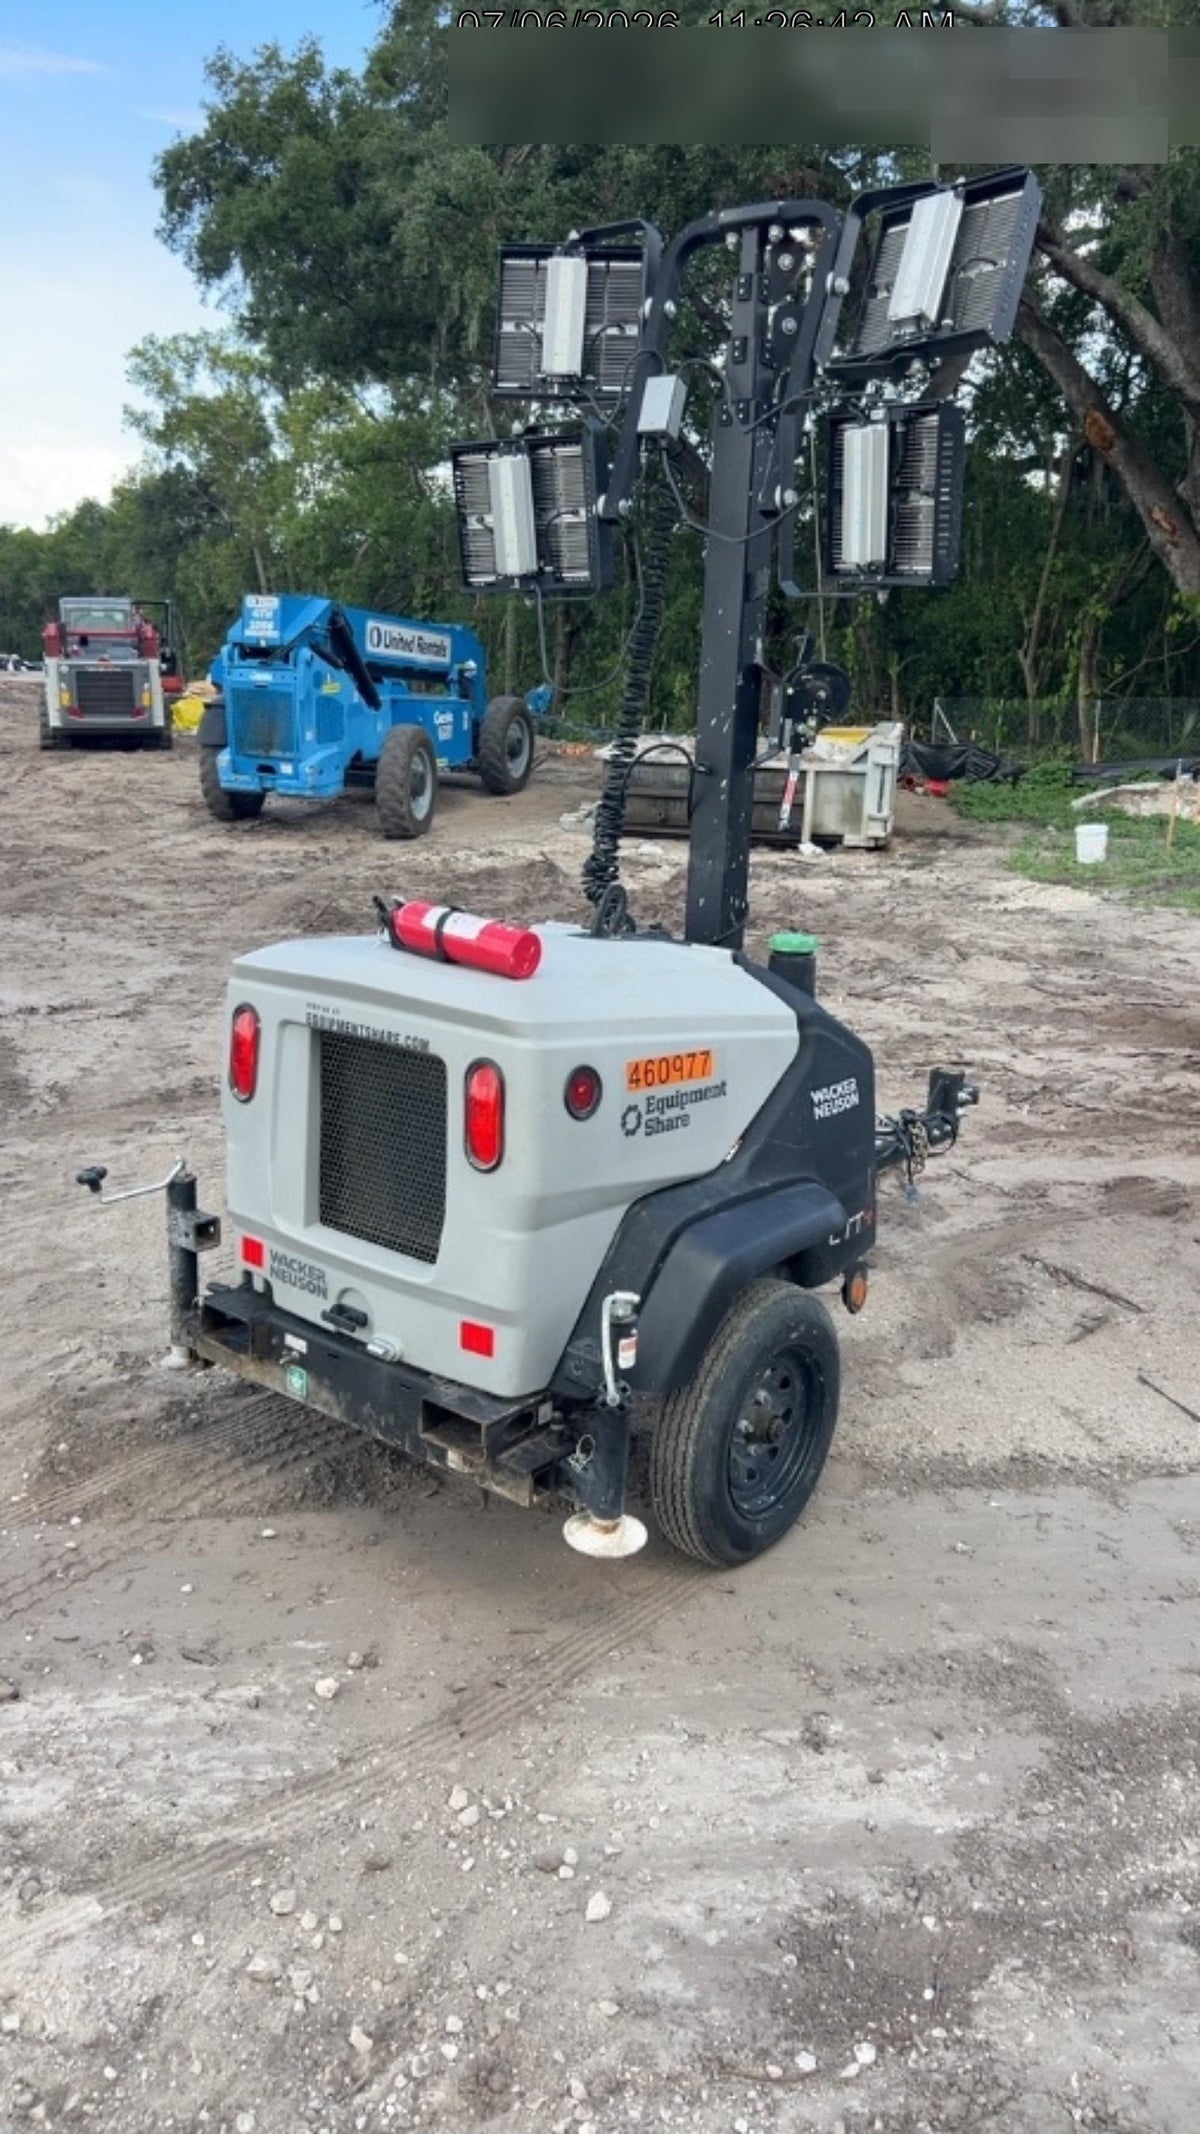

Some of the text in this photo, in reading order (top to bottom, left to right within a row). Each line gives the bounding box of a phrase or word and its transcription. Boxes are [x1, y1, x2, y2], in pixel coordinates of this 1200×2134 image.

[384, 630, 447, 658] United Rentals
[628, 1050, 711, 1089] 460977
[645, 1080, 727, 1115] Equipment
[810, 1078, 857, 1104] WACKER
[813, 1093, 859, 1120] NEUSON
[644, 1113, 690, 1137] Share
[269, 1248, 326, 1284] WACKER
[269, 1263, 328, 1301] NEUSON
